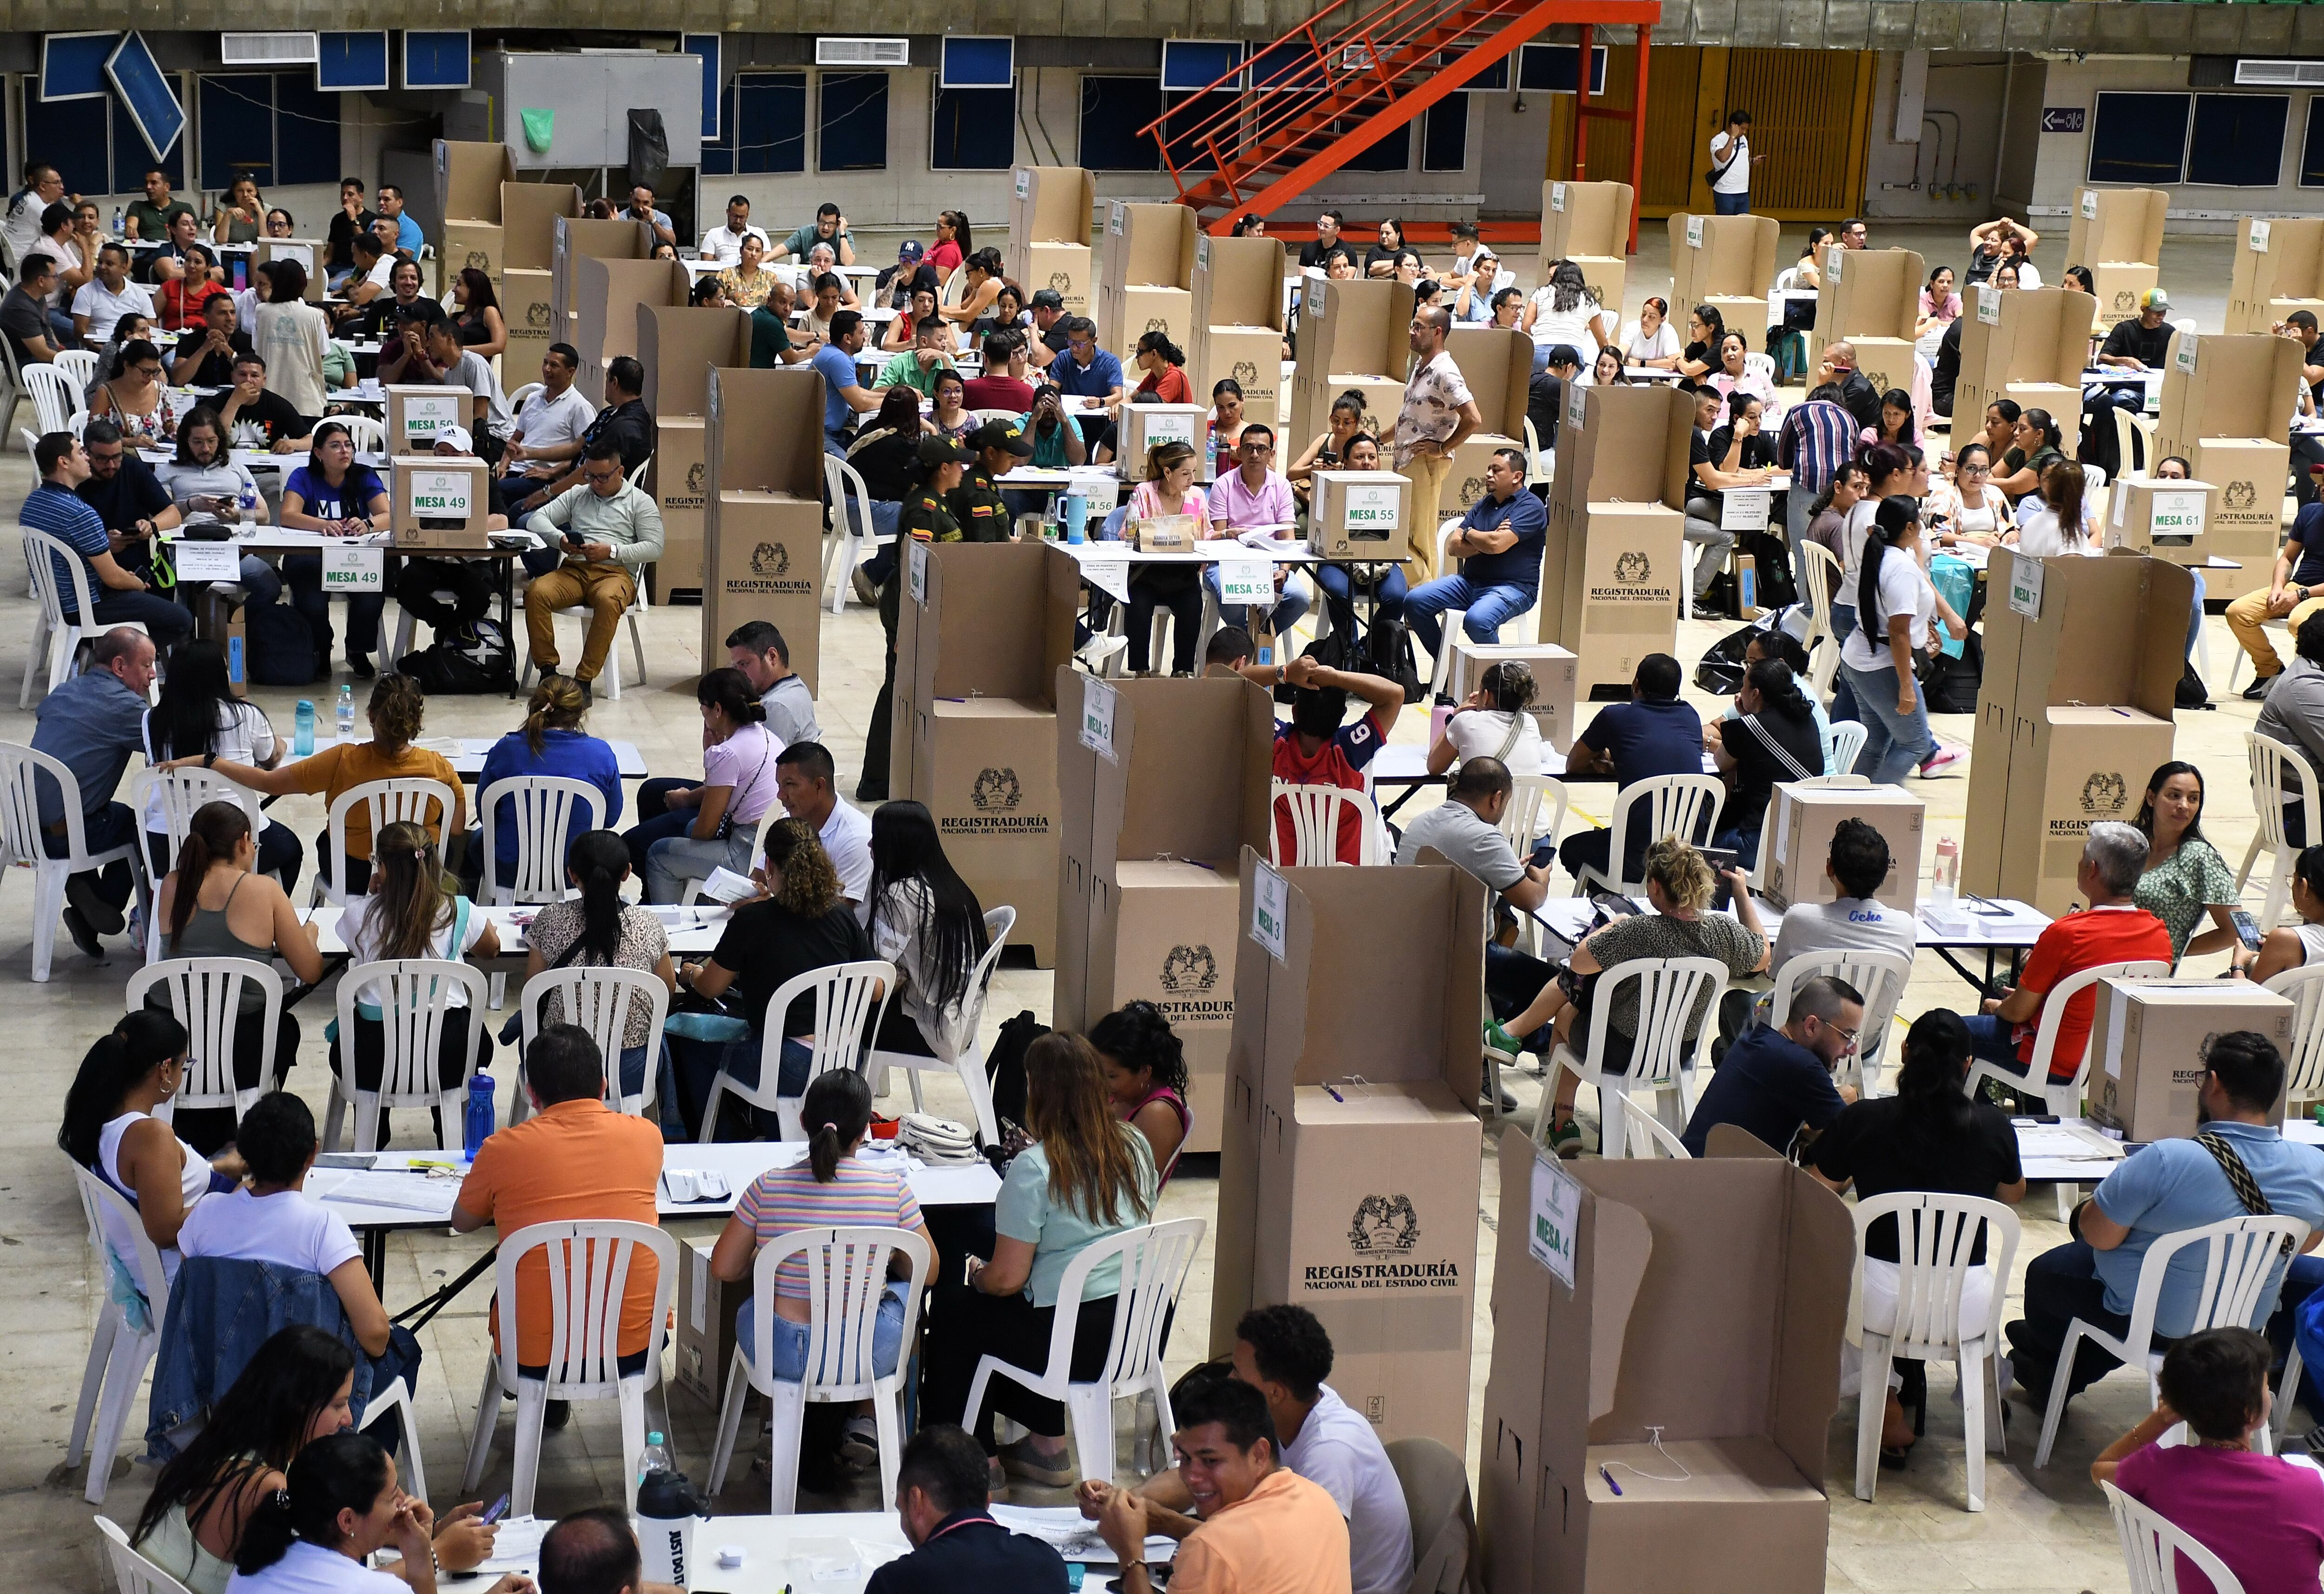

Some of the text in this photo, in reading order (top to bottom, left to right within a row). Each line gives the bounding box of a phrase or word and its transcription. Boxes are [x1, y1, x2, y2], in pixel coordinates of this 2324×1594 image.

[408, 420, 436, 430] MESA
[415, 497, 465, 508] MESA 49
[1099, 502, 1112, 510] 56
[1349, 509, 1394, 520] MESA 55
[2156, 515, 2199, 526] MESA 61
[326, 572, 377, 583] MESA 49
[726, 579, 811, 589] REGISTRADURÍA
[1226, 584, 1270, 594] MESA 55
[1591, 587, 1670, 596] REGISTRADURÍA
[2014, 585, 2037, 605] MESA 7
[1087, 714, 1109, 740] MESA 2
[941, 815, 1049, 826] REGISTRADURÍA
[1849, 909, 1882, 922] Ocho
[1258, 906, 1280, 941] MESA 3
[1536, 1213, 1569, 1261] MESA 4
[1305, 1259, 1458, 1279] REGISTRADURÍA
[1304, 1280, 1358, 1290] NACIONAL
[1430, 1278, 1458, 1287] CIVIL
[672, 1556, 684, 1574] DO
[673, 1574, 685, 1585] IT
